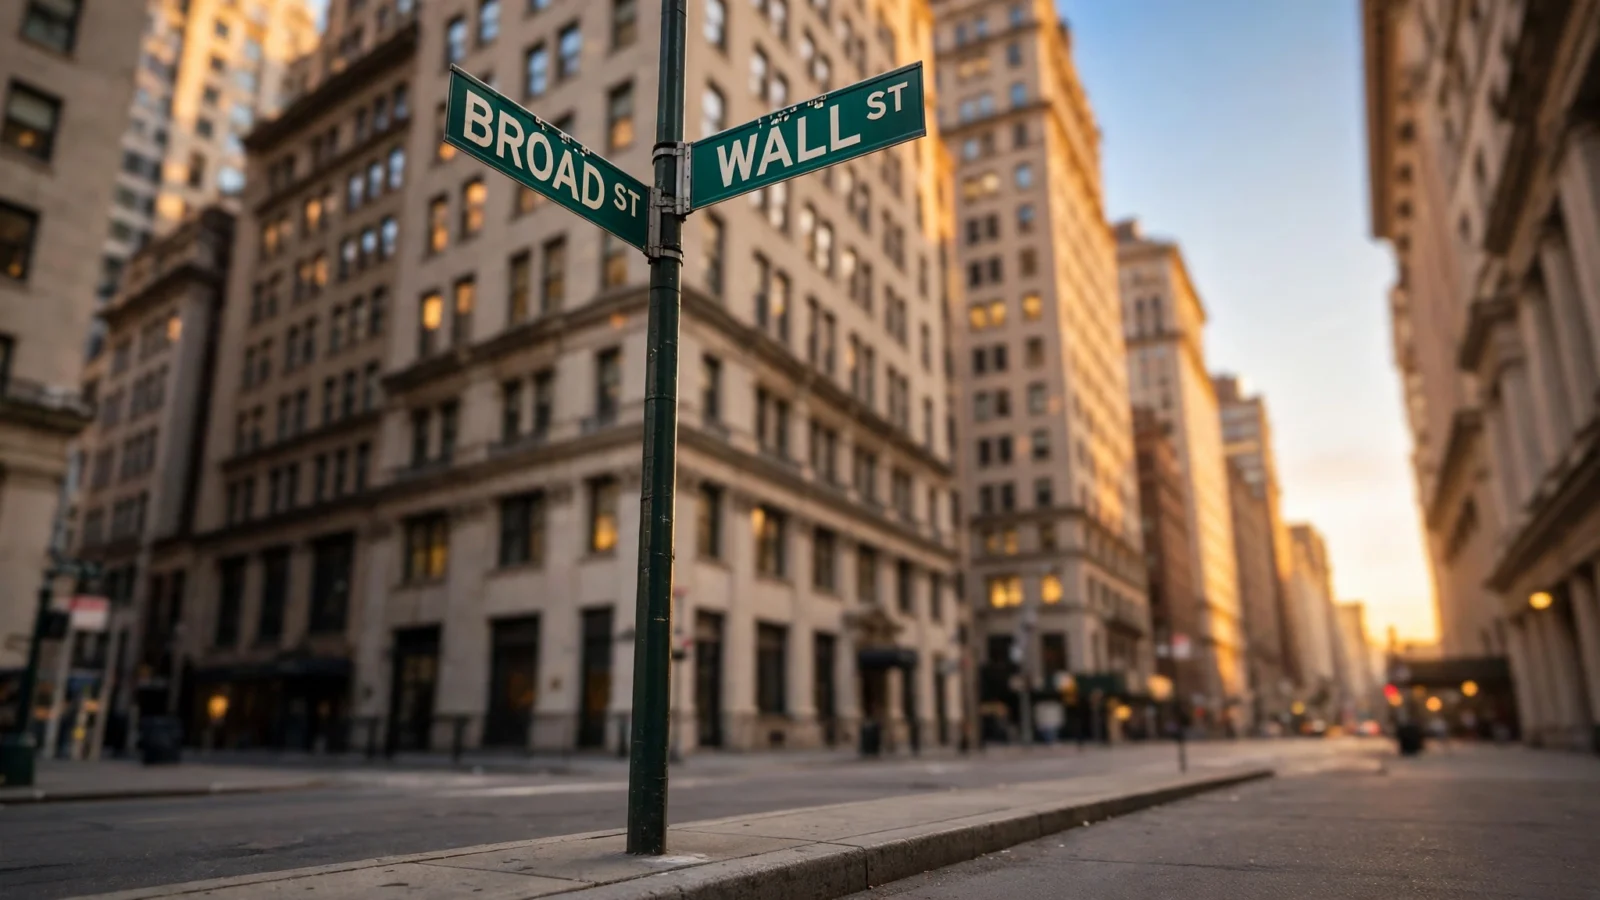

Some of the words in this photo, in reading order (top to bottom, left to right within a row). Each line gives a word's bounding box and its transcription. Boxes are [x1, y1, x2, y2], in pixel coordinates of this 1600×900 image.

[463, 89, 605, 210] BROAD
[613, 182, 641, 217] ST
[716, 104, 861, 188] WALL
[866, 81, 908, 120] ST
